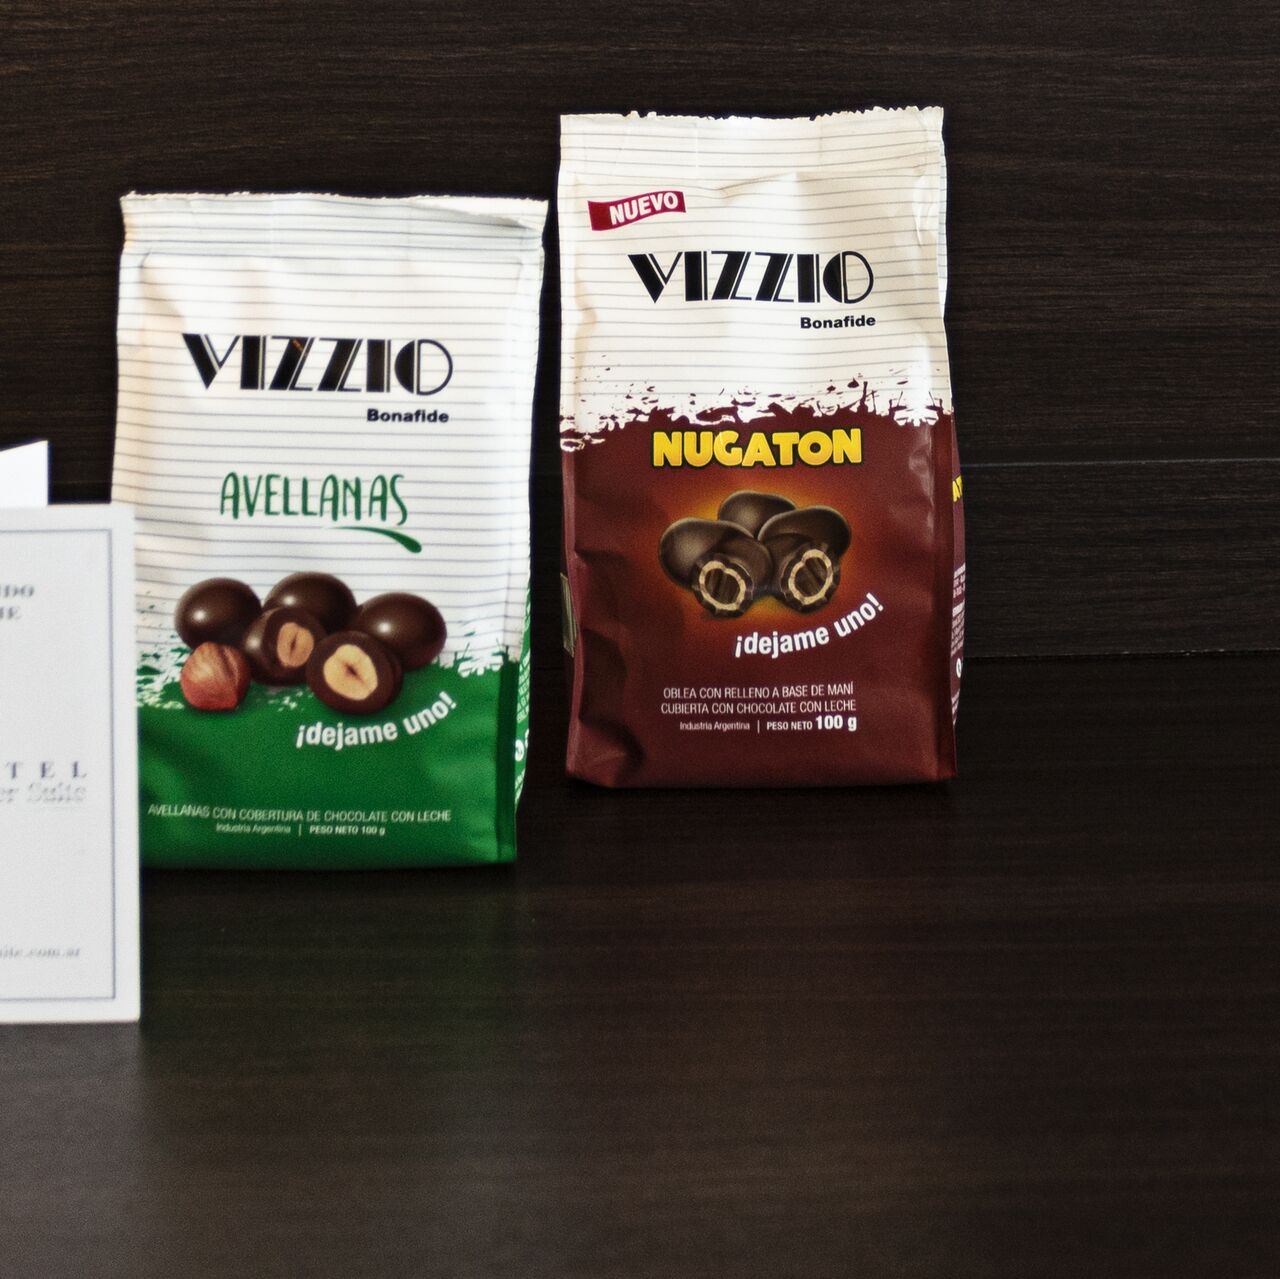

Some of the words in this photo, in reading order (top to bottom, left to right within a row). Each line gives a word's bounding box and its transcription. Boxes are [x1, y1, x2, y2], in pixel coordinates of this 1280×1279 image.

[609, 192, 679, 225] NUEVO
[628, 250, 874, 304] VIZZIO
[800, 315, 876, 329] Bonafide
[182, 333, 453, 396] VIZZIO
[366, 408, 449, 424] Bonafide
[653, 428, 862, 467] NUGATON
[219, 471, 409, 526] AVELLANAS
[735, 626, 830, 659] ¡dejame
[834, 592, 884, 638] uno!
[663, 687, 697, 699] OBLEA
[699, 687, 721, 699] CON
[724, 686, 769, 699] RELLENO
[772, 686, 780, 698] A
[782, 685, 807, 697] BASE
[811, 684, 824, 696] DE
[827, 681, 854, 695] MANÍ
[661, 703, 709, 714] CUBIERTA
[711, 703, 734, 714] CON
[736, 702, 797, 714] CHOCOLATE
[800, 701, 821, 713] CON
[824, 699, 856, 712] LECHE
[296, 720, 398, 751] ¡dejame
[403, 691, 457, 734] uno!
[680, 721, 712, 731] Industria
[713, 721, 750, 732] Argentina
[766, 721, 789, 731] PESO
[791, 721, 813, 731] NETO
[815, 714, 843, 730] 100
[847, 716, 857, 732] g
[147, 803, 210, 818] AVELLANAS
[213, 807, 236, 820] CON
[239, 808, 304, 821] COBERTURA
[306, 809, 321, 821] DE
[324, 809, 388, 822] CHOCOLATE
[391, 810, 415, 822] CON
[417, 809, 452, 822] LECHE
[216, 822, 250, 834] Industria
[252, 823, 291, 835] Argentina
[309, 824, 332, 835] PESO
[335, 824, 358, 835] NETO
[361, 824, 377, 835] 100
[379, 827, 386, 837] g
